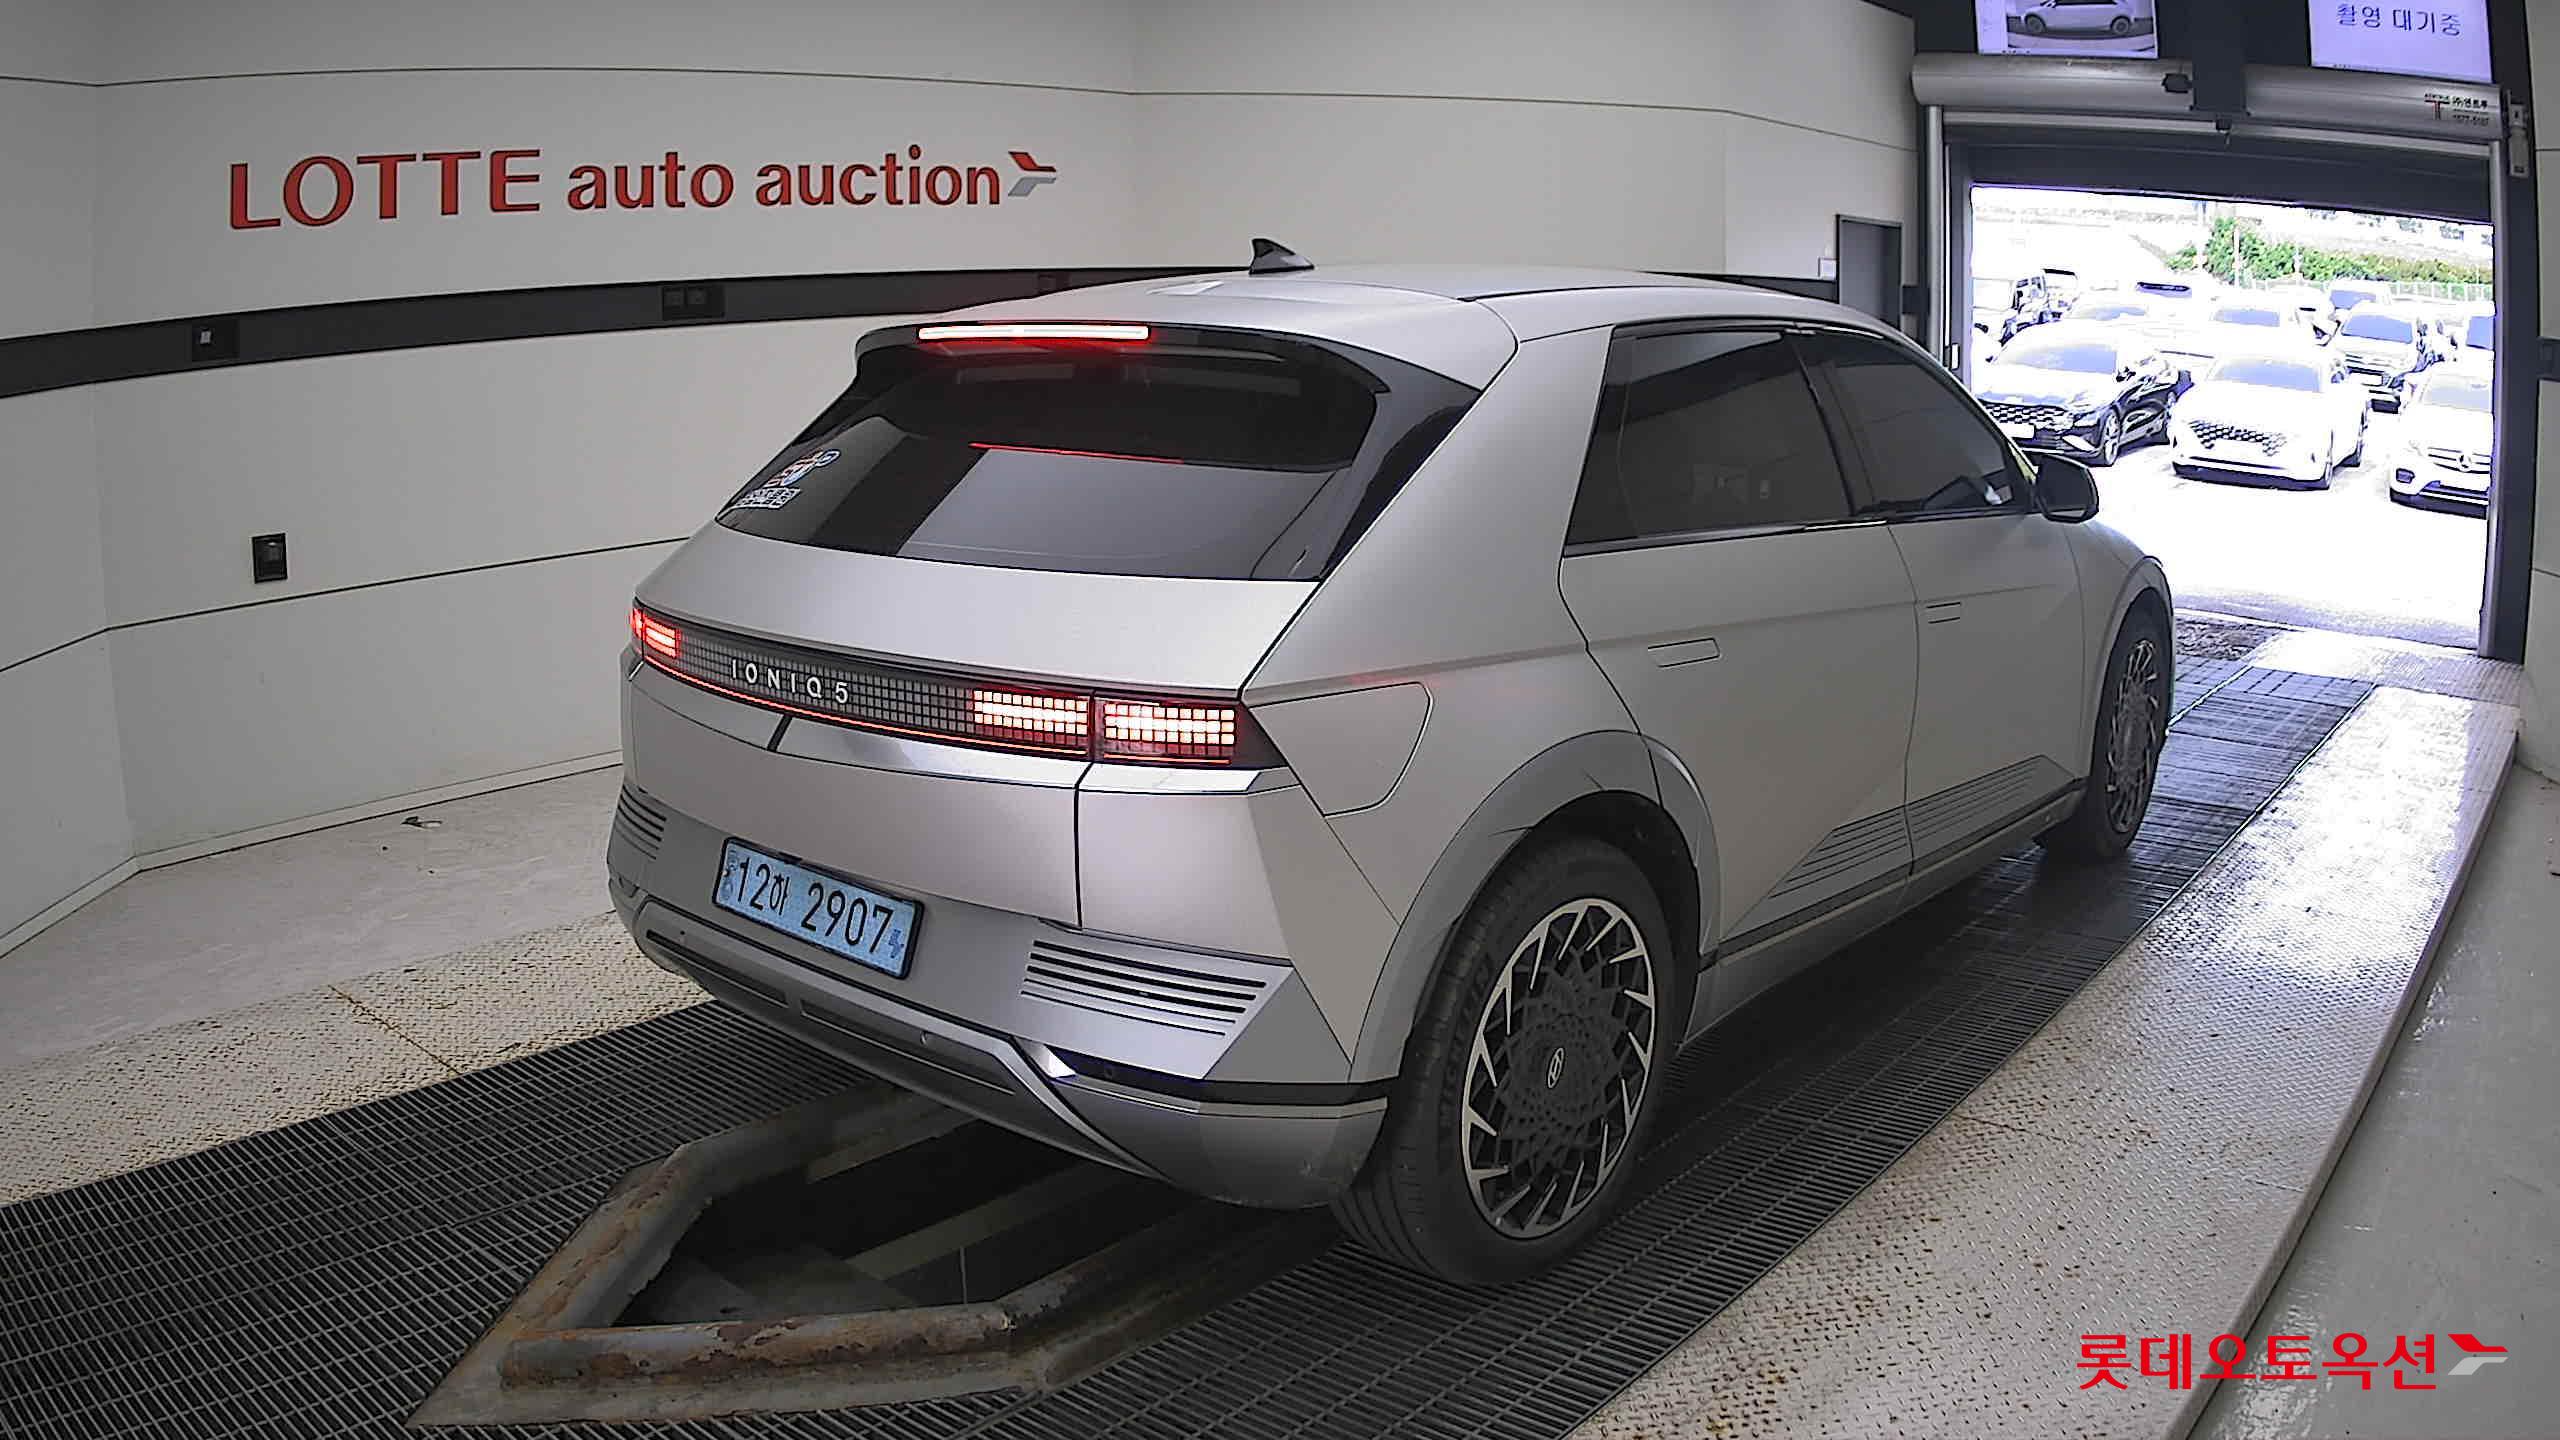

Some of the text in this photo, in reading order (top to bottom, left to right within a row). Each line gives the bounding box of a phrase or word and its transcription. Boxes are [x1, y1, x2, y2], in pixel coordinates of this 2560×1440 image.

[2336, 3, 2462, 37] 촬영 대기중
[229, 144, 1003, 231] LOTTE auto auction
[731, 658, 849, 704] IONIQ 5
[800, 881, 896, 954] 2907
